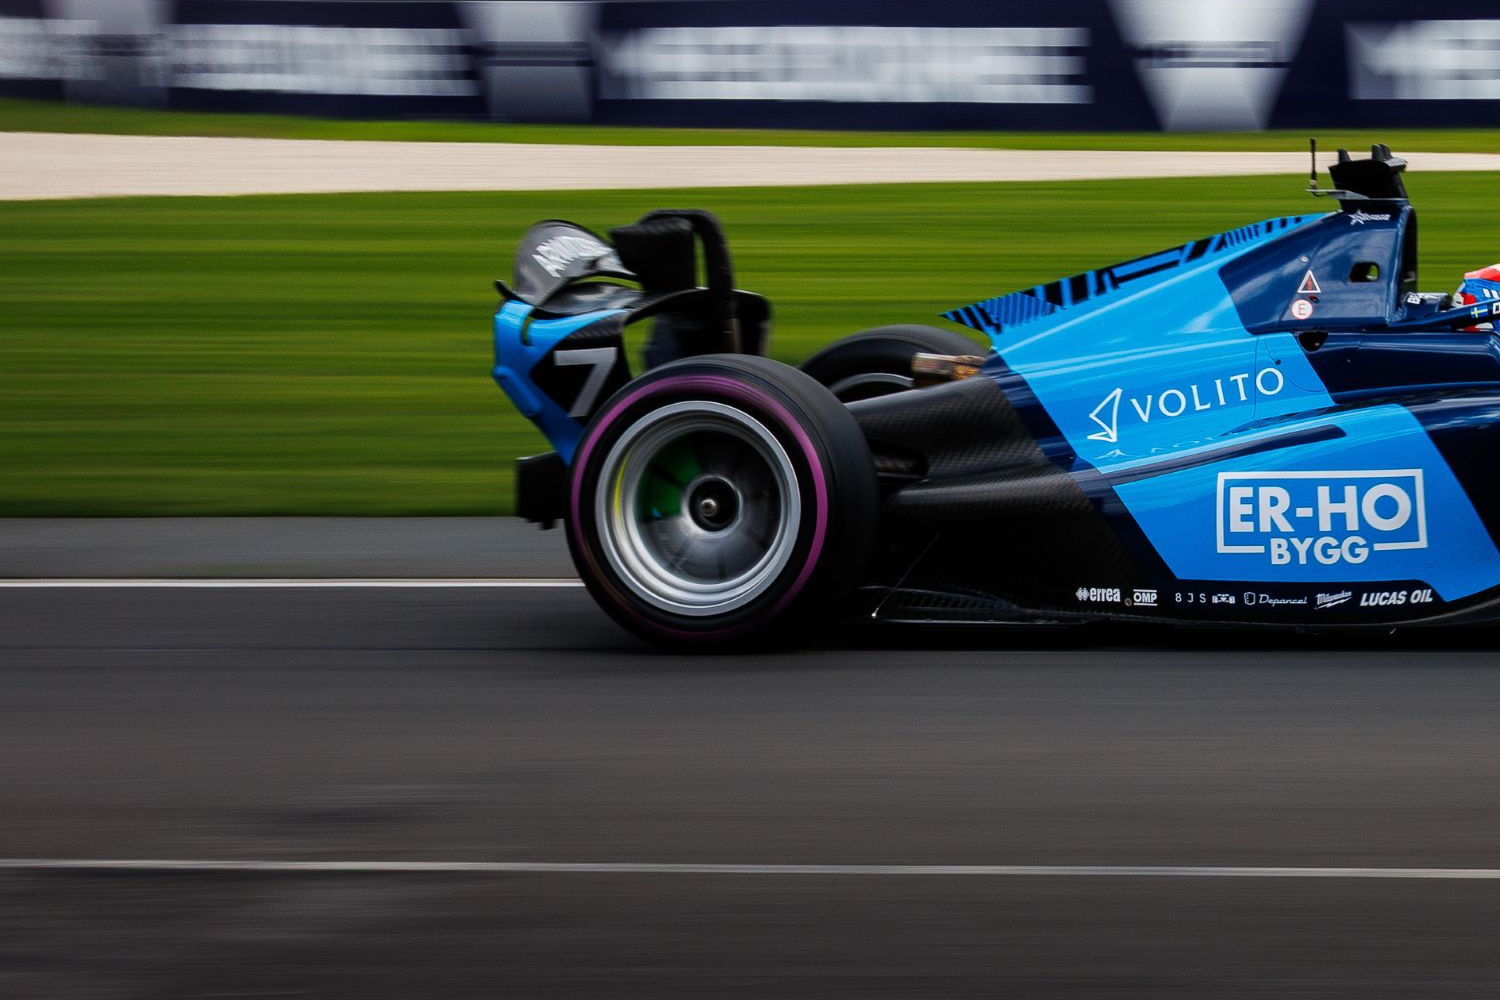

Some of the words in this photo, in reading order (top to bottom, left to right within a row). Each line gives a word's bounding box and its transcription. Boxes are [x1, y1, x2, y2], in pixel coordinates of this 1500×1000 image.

[554, 347, 618, 418] 7
[1130, 366, 1285, 424] VOLITO
[1228, 483, 1412, 533] ER-HO
[1270, 536, 1370, 566] BYGG
[1133, 592, 1158, 603] OMP
[1359, 590, 1407, 607] LUCAS
[1410, 588, 1433, 604] OIL
